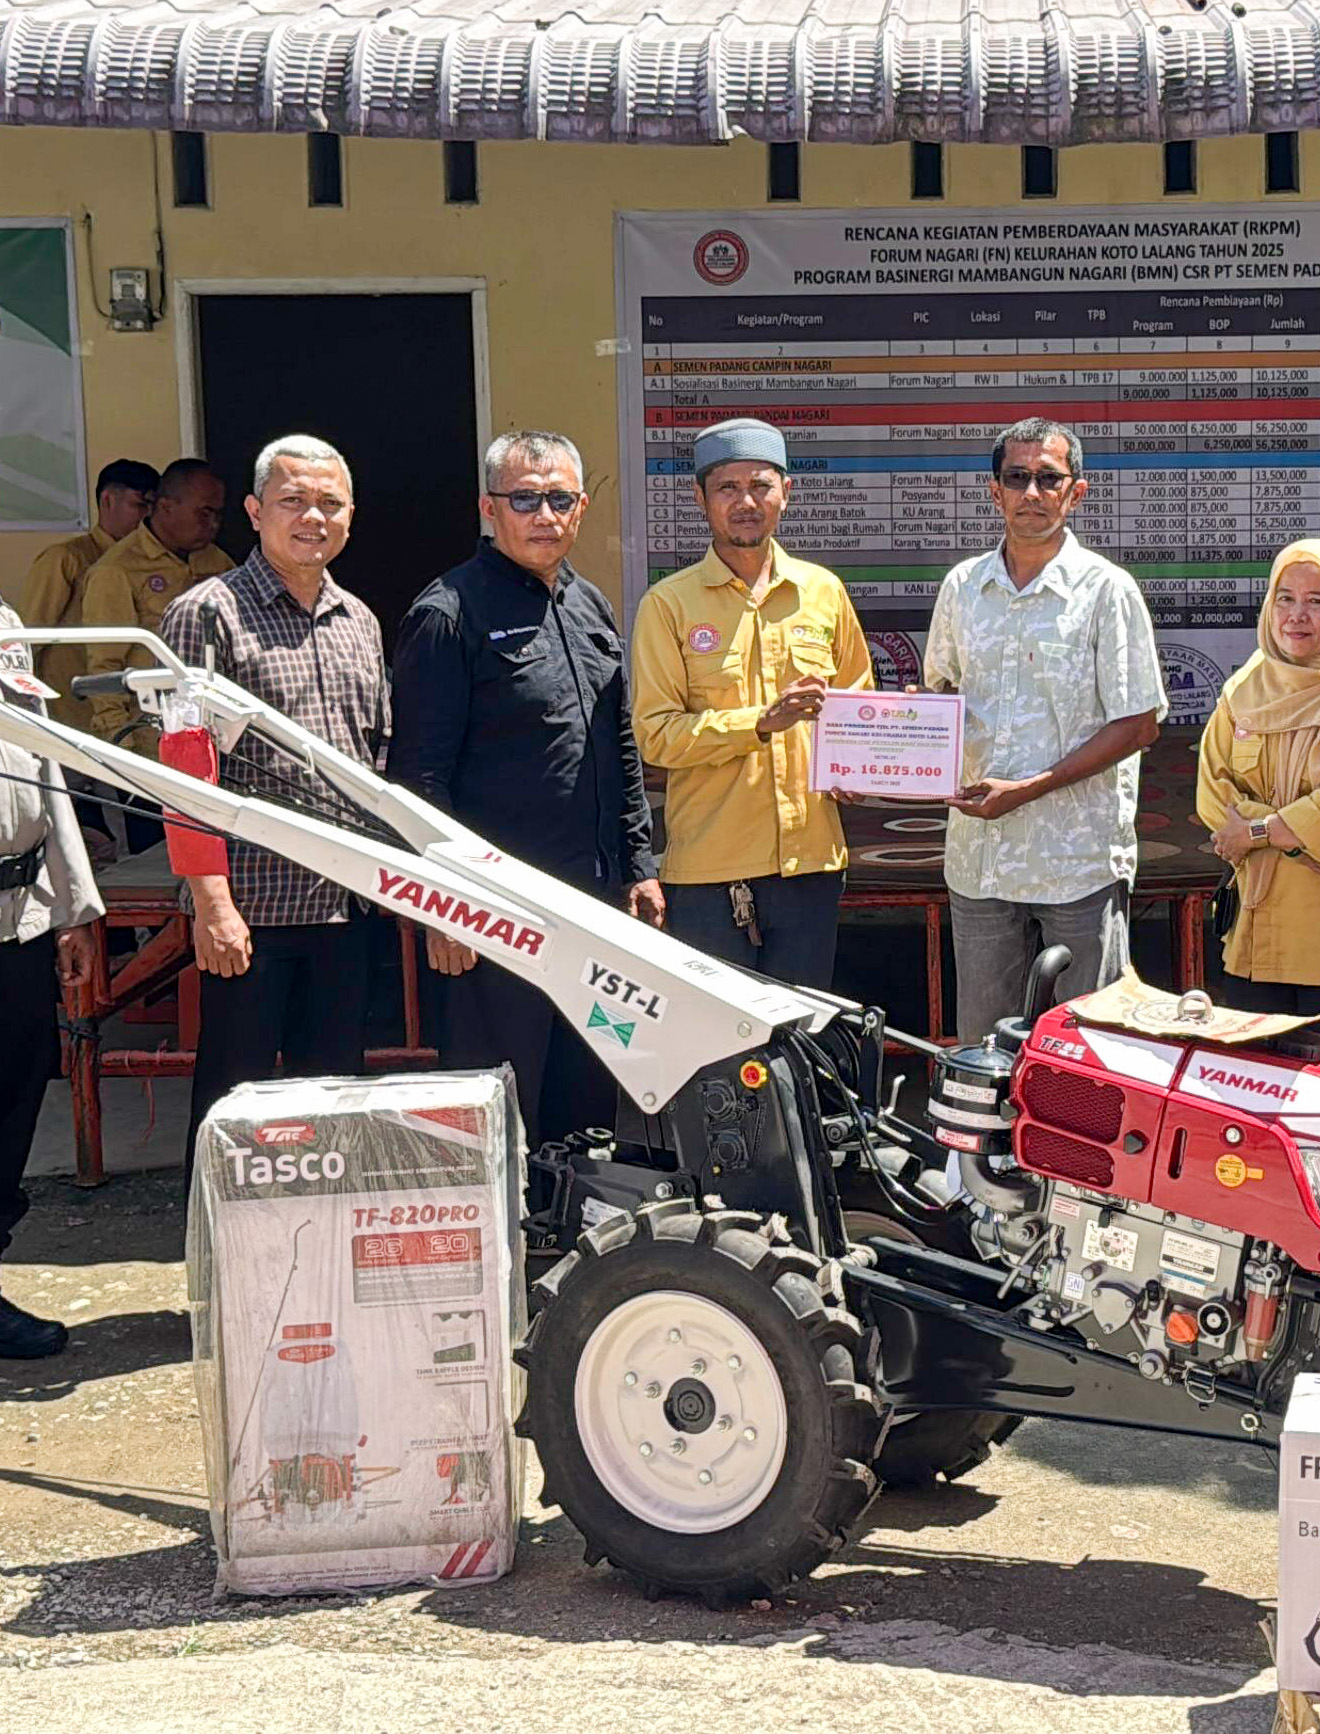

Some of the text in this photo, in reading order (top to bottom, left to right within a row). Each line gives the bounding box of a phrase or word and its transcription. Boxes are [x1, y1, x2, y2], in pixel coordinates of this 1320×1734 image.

[844, 219, 1301, 242] RENCANA KEGIATAN PEMBERDAYAAN MASYARAKAT (RKPM)
[870, 243, 1284, 264] FORUM NAGARI (FN) KELURAHAN KOTO LALANG TAHUN 2025
[794, 269, 871, 285] PROGRAM
[876, 268, 953, 284] BASINERGI
[958, 266, 1065, 283] MAMBANGUN
[1069, 265, 1126, 281] NAGARI
[1131, 264, 1178, 283] (BMN)
[1182, 264, 1209, 279] CSR
[1214, 264, 1230, 279] PT
[1236, 263, 1288, 278] SEMEN
[1159, 293, 1284, 309] Rencana Pembiayaan (Rp)
[649, 315, 663, 326] No
[737, 313, 824, 328] Kegiatan/Program
[913, 312, 930, 323] PIC
[970, 311, 1001, 323] Lokasi
[1034, 310, 1058, 322] Pilar
[1088, 310, 1106, 321] TPB
[1133, 320, 1174, 333] Program
[1209, 319, 1231, 331] BOP
[1270, 318, 1305, 330] Jumlah
[673, 359, 832, 373] SEMEN PADANG CAMPIN NAGARI
[650, 379, 666, 389] A.1
[673, 375, 857, 391] Sosialisasi Basinergi Mambangun Nagari
[891, 374, 953, 388] Forum Nagari
[974, 374, 991, 385] RW
[1024, 373, 1068, 385] Hukum &
[1082, 372, 1113, 383] TPB 17
[674, 394, 697, 405] Total
[892, 426, 954, 440] Forum Nagari
[959, 426, 980, 437] Koto
[1082, 425, 1099, 435] TPB
[801, 476, 854, 490] Koto Lalang
[893, 475, 954, 488] Forum Nagari
[828, 491, 868, 504] Posyandu
[901, 489, 946, 502] Posyandu
[807, 507, 866, 520] Arang Batok
[902, 506, 945, 519] KU Arang
[807, 522, 828, 533] Huni
[830, 522, 850, 536] bagi
[852, 522, 885, 534] Rumah
[893, 521, 954, 535] Forum Nagari
[799, 538, 860, 549] Muda Produktif
[894, 538, 950, 549] Karang Taruna
[904, 585, 922, 594] KAN
[830, 763, 942, 777] Rp. 16.875.000
[378, 867, 546, 956] YANMAR
[589, 961, 660, 1019] YST-L
[1199, 1065, 1298, 1102] YANMAR
[226, 1147, 346, 1186] Tasco
[353, 1203, 480, 1228] TF-820PRO
[364, 1233, 469, 1258] 26 20
